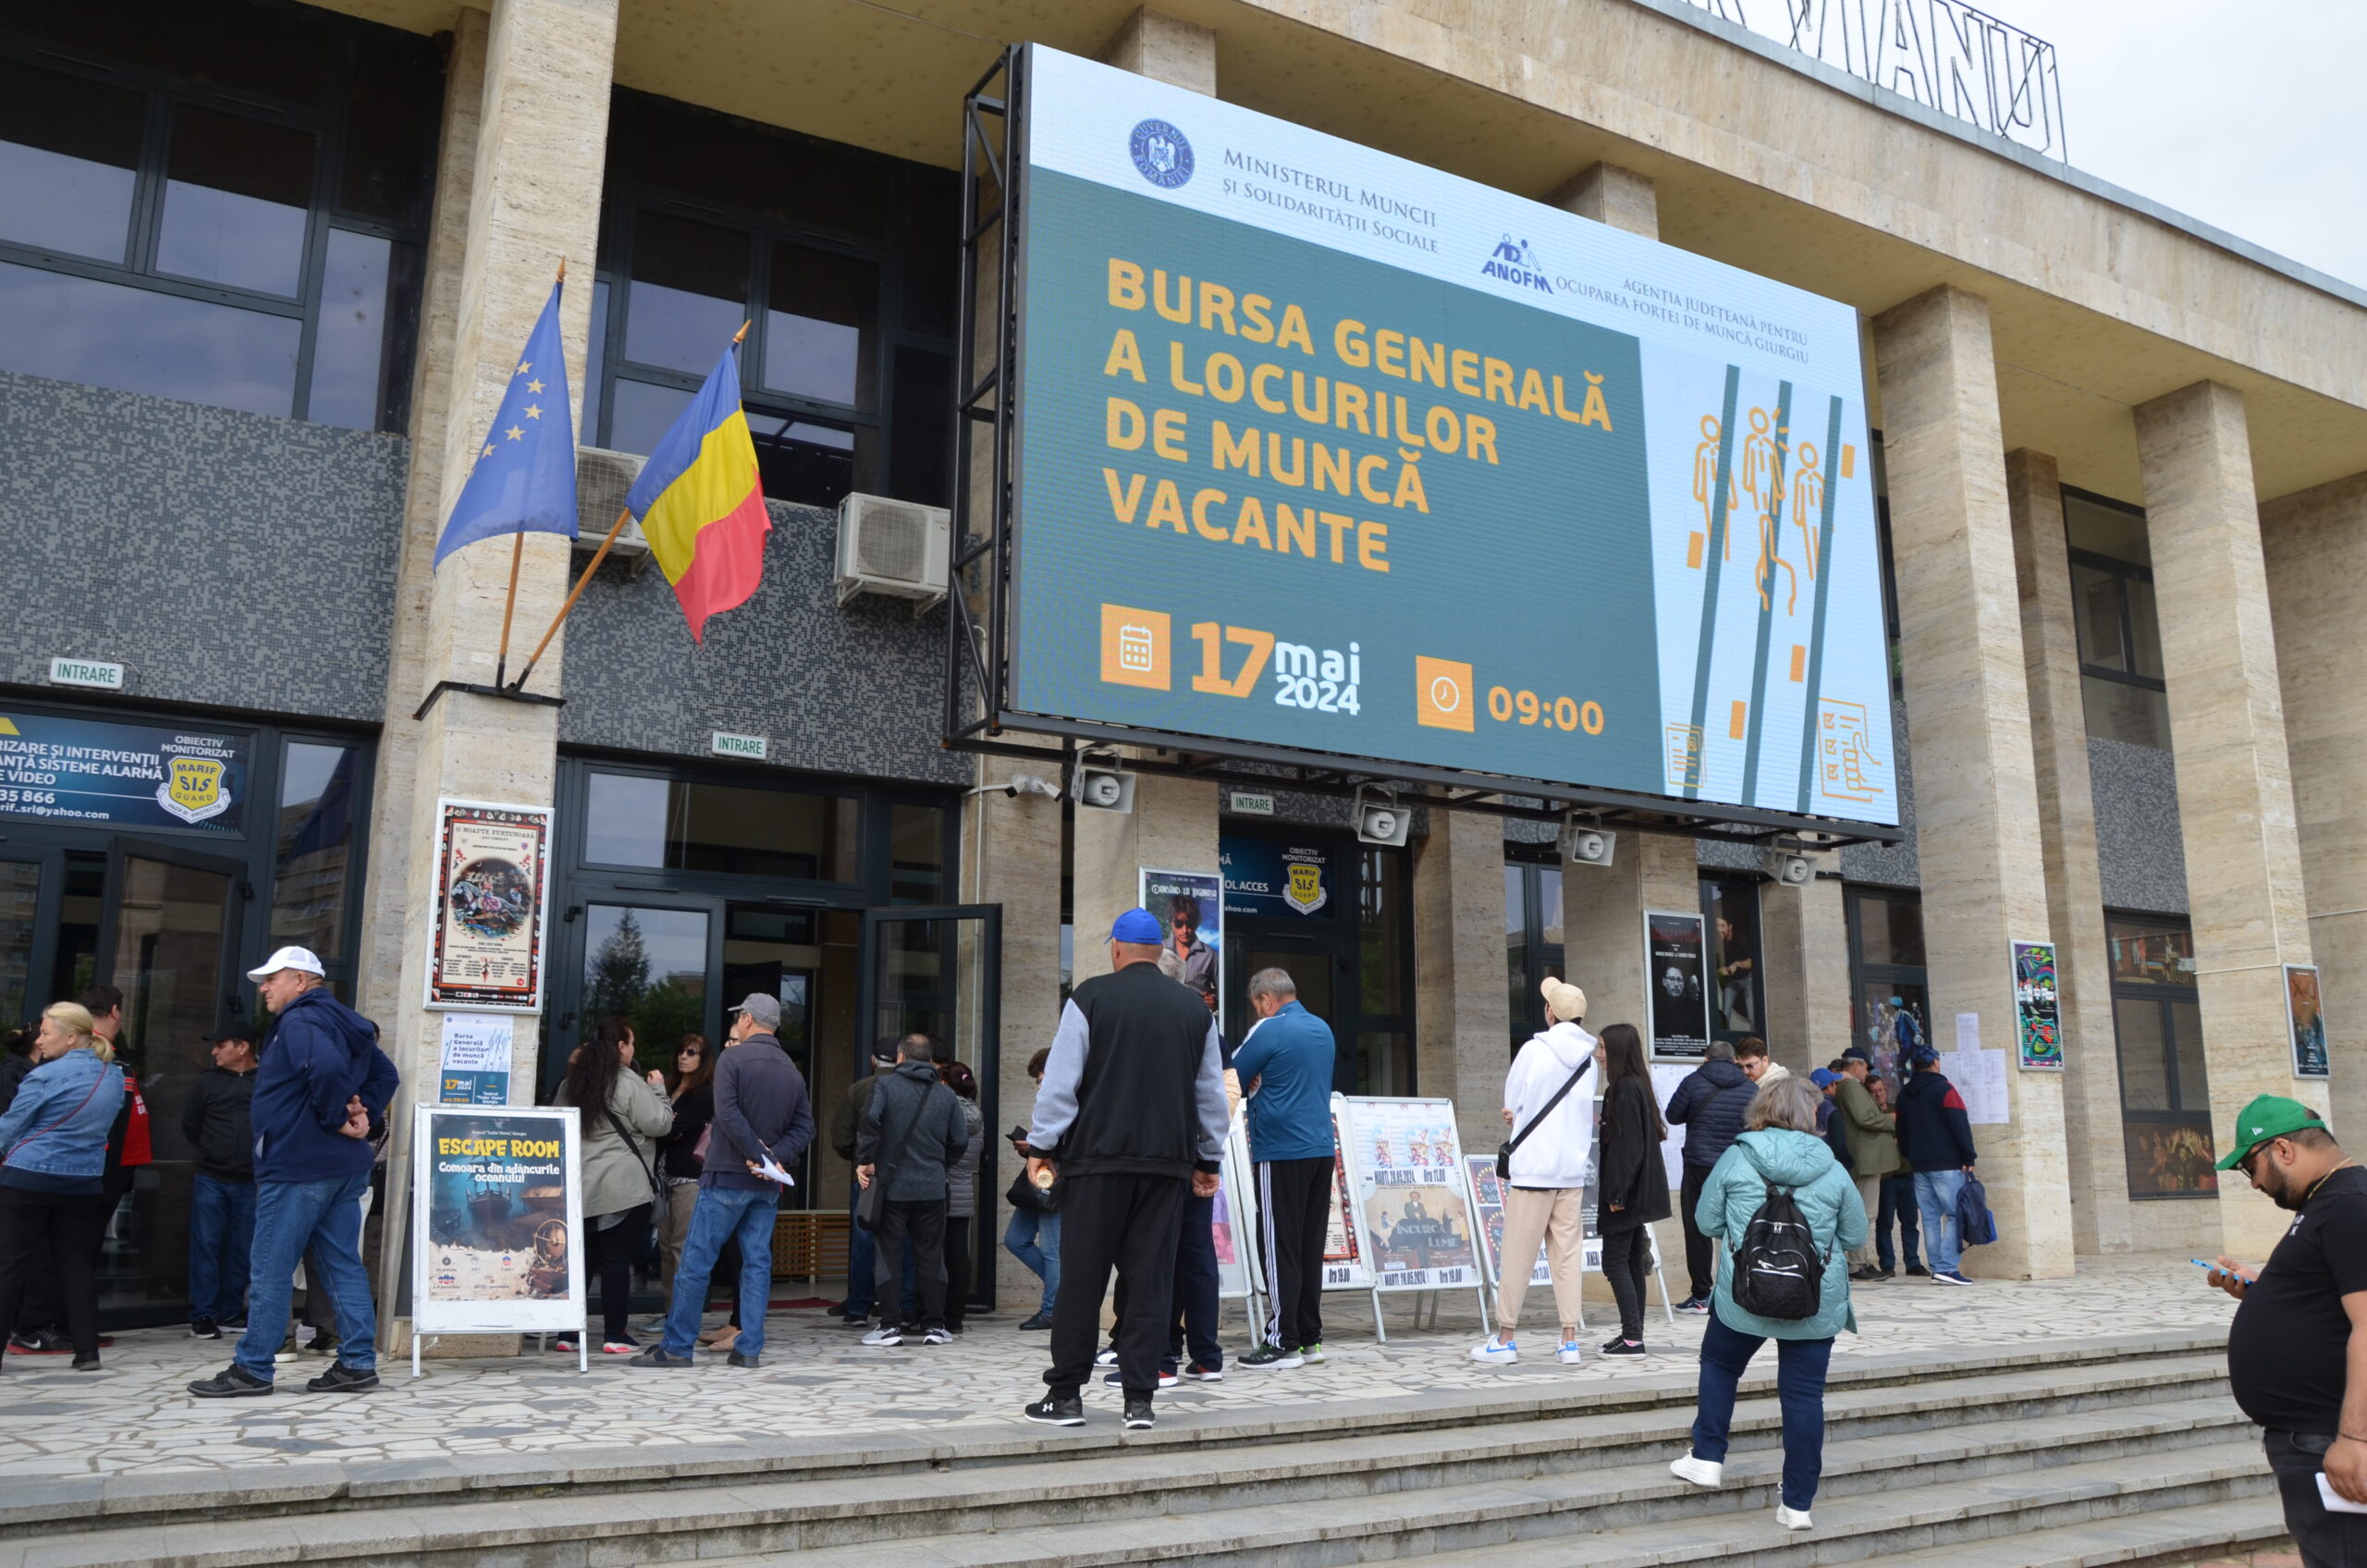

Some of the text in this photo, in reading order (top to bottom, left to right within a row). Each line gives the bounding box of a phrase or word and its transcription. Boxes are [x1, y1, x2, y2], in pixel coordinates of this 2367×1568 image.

[1223, 148, 1437, 228] MINISTERUL MUNCII
[1373, 221, 1439, 254] SOCIALE
[1481, 260, 1554, 295] ANOFM
[1555, 276, 1630, 310] OCUPAREA
[1684, 314, 1701, 331] DE
[1755, 338, 1809, 364] GIURGIU
[1760, 321, 1809, 347] PENTRU
[1108, 257, 1613, 433] BURSA GENERALĂ
[1104, 328, 1500, 466] A LOCURILOR
[1107, 397, 1430, 515] DE MUNCĂ
[1102, 467, 1390, 573] VACANTE
[1191, 621, 1361, 699] 17 mai
[56, 662, 116, 684] INTRARE
[1274, 674, 1361, 717] 2024
[1487, 685, 1605, 736] 09:00
[175, 735, 224, 748] OBIECTIV
[718, 736, 762, 754] INTRARE
[161, 743, 235, 758] MONITORIZAT
[39, 758, 100, 775] SISTEME
[102, 765, 164, 780] ALARMĂ
[177, 764, 217, 775] MARIF
[7, 770, 55, 785] VIDEO
[22, 790, 55, 804] 866
[176, 791, 214, 802] GUARD
[1235, 796, 1270, 811] INTRARE
[1282, 853, 1326, 864] MONITORIZAT
[1290, 847, 1318, 856] OBIECTIV
[1240, 881, 1269, 892] ACCES
[445, 1079, 460, 1090] 17
[438, 1137, 559, 1158] ESCAPE ROOM
[438, 1161, 560, 1175] Comoara din adâncurile
[1423, 1169, 1432, 1182] Ora
[474, 1172, 525, 1183] oceanului
[1329, 1268, 1337, 1283] Ora
[1440, 1270, 1449, 1284] Ora
